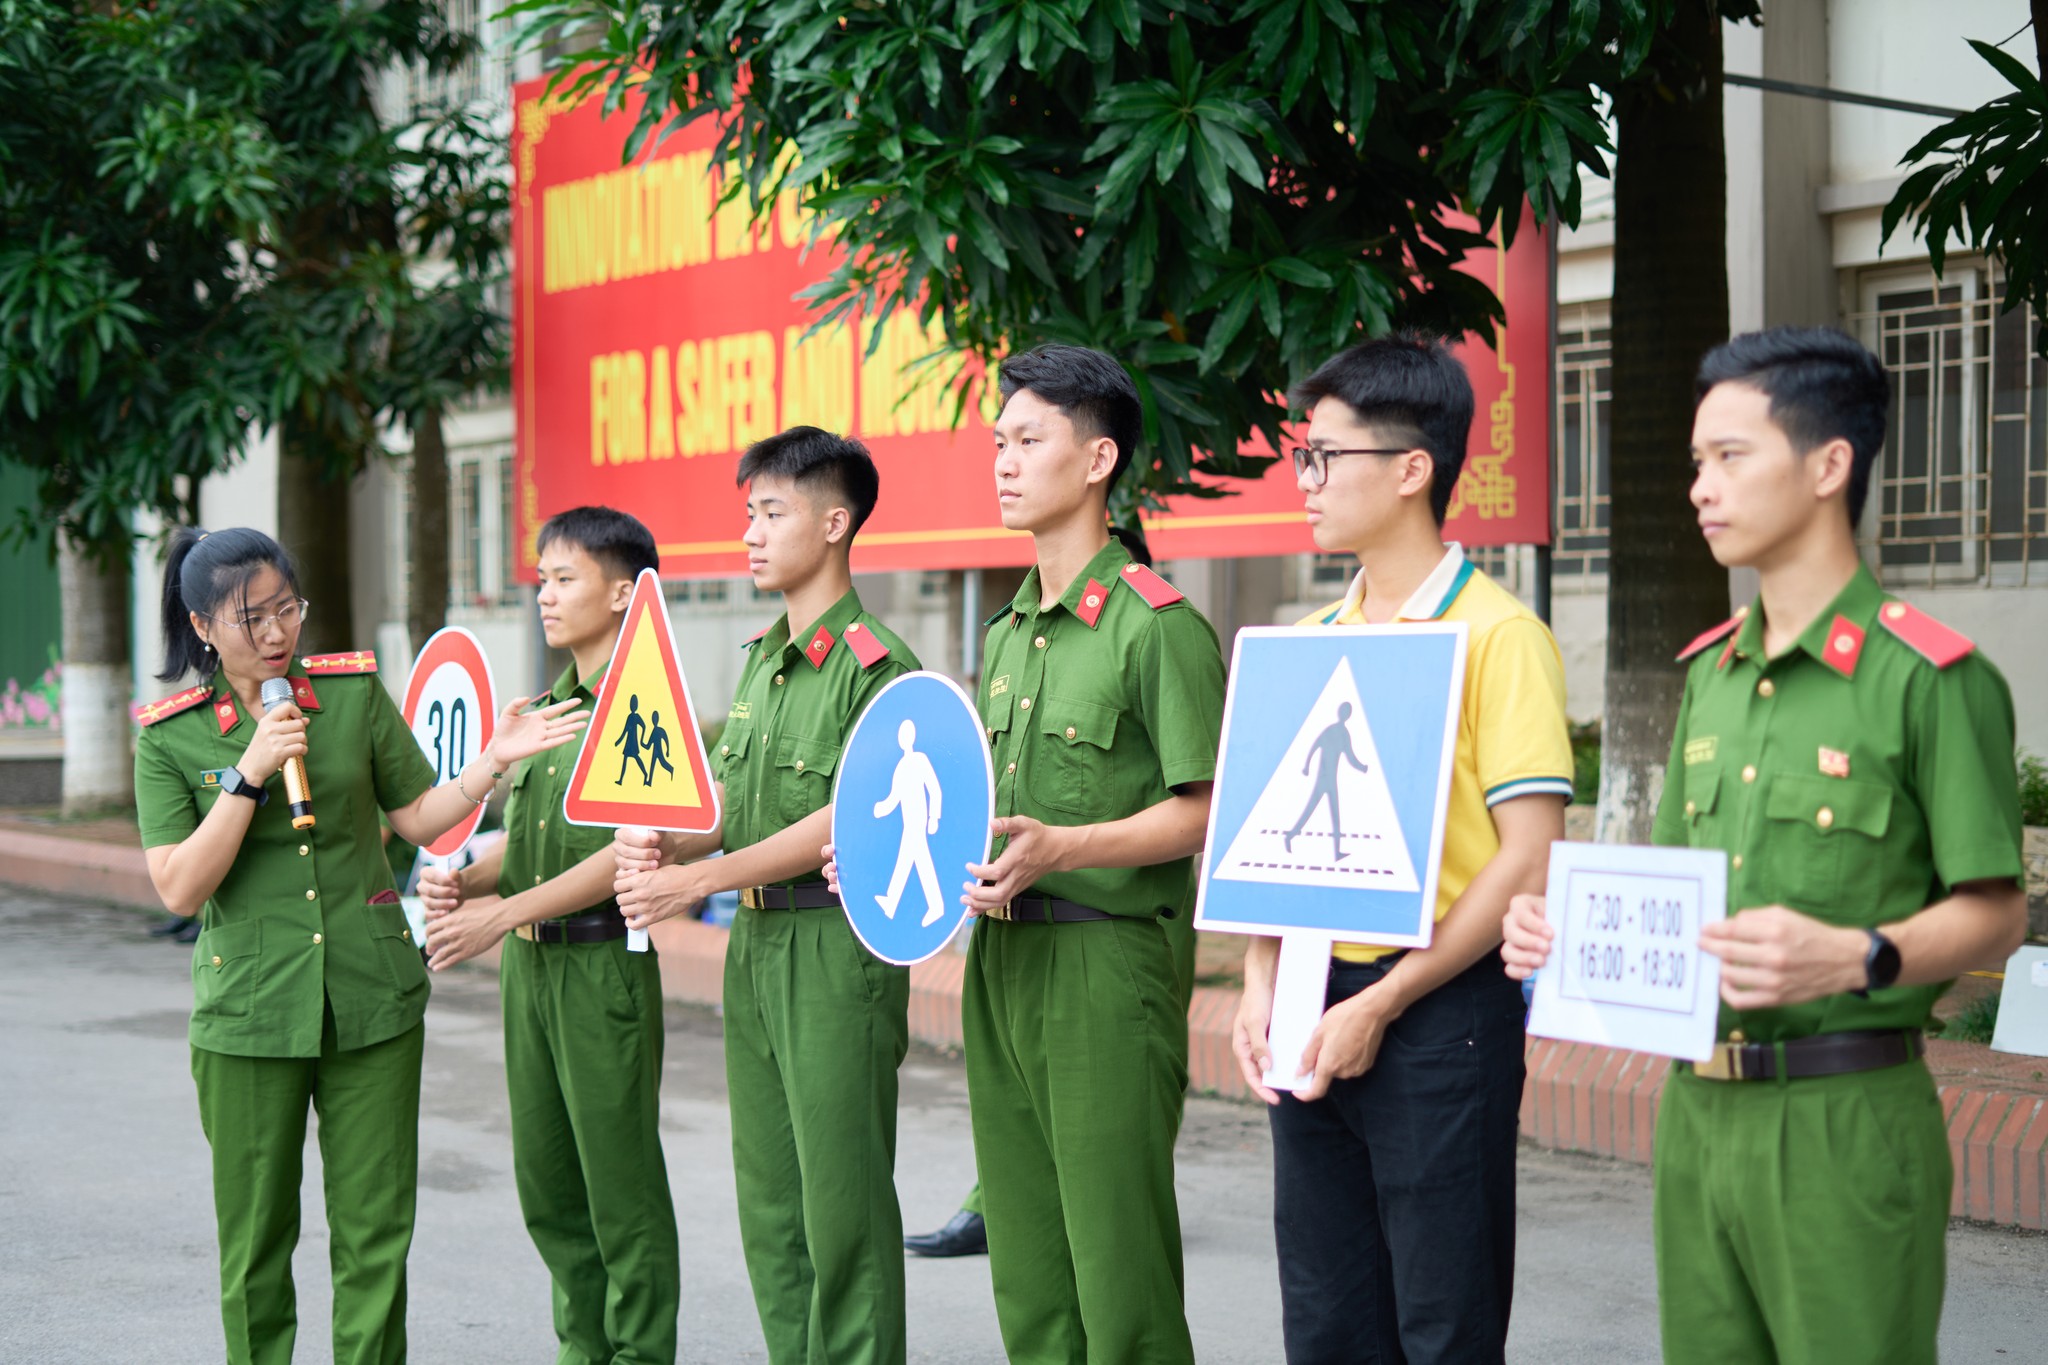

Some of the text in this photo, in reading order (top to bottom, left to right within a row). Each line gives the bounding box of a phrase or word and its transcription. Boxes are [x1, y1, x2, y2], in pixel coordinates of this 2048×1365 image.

[543, 148, 712, 294] INNOVATION
[590, 349, 647, 466] FOR
[649, 345, 675, 459] A
[676, 329, 776, 459] SAFER
[782, 316, 854, 438] AND
[428, 697, 466, 788] 30
[1586, 893, 1621, 931] 7:30
[1641, 898, 1682, 938] 10:00
[1579, 942, 1623, 982] 16:00
[1643, 949, 1685, 989] 18:30
